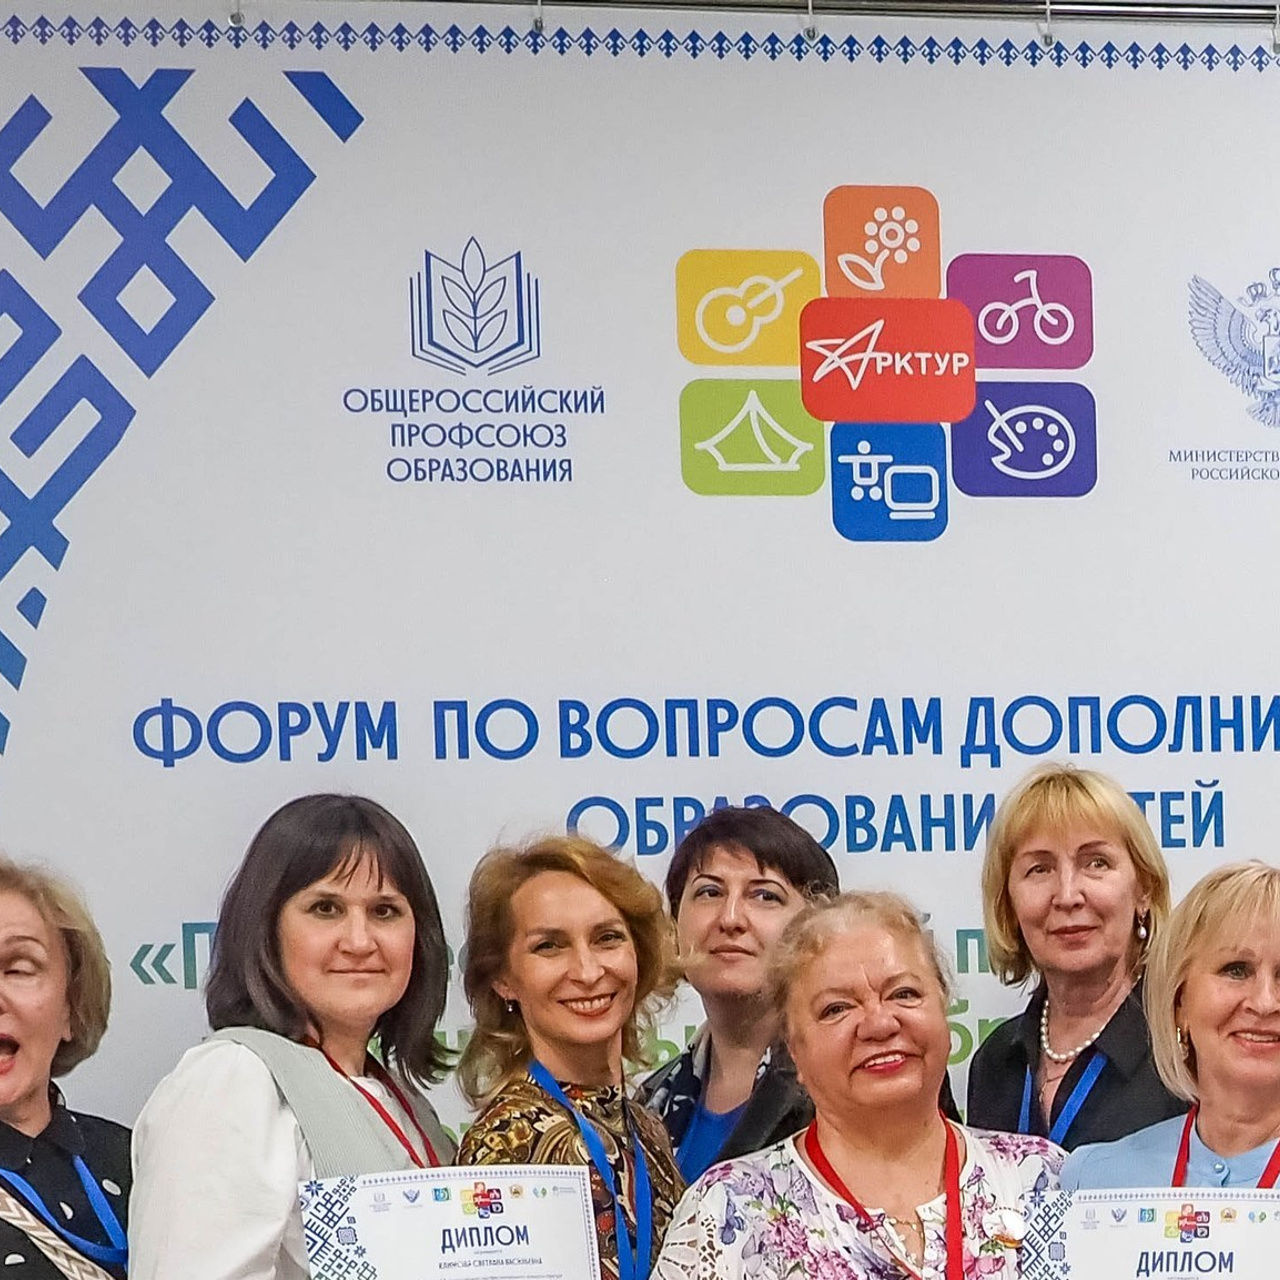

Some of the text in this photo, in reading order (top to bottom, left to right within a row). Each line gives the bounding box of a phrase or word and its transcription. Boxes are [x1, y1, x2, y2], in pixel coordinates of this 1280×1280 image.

[343, 385, 605, 418] ОБЩЕРОССИЙСКИЙ
[391, 422, 567, 449] ПРОФСОЮЗ
[387, 457, 573, 482] ОБРАЗОВАНИЯ
[132, 697, 398, 768] ФОРУМ
[433, 698, 540, 761] ПО
[559, 696, 943, 758] ВОПРОСАМ
[441, 1224, 530, 1254] ДИПЛОМ
[1136, 1251, 1234, 1278] ДИПЛОМ
